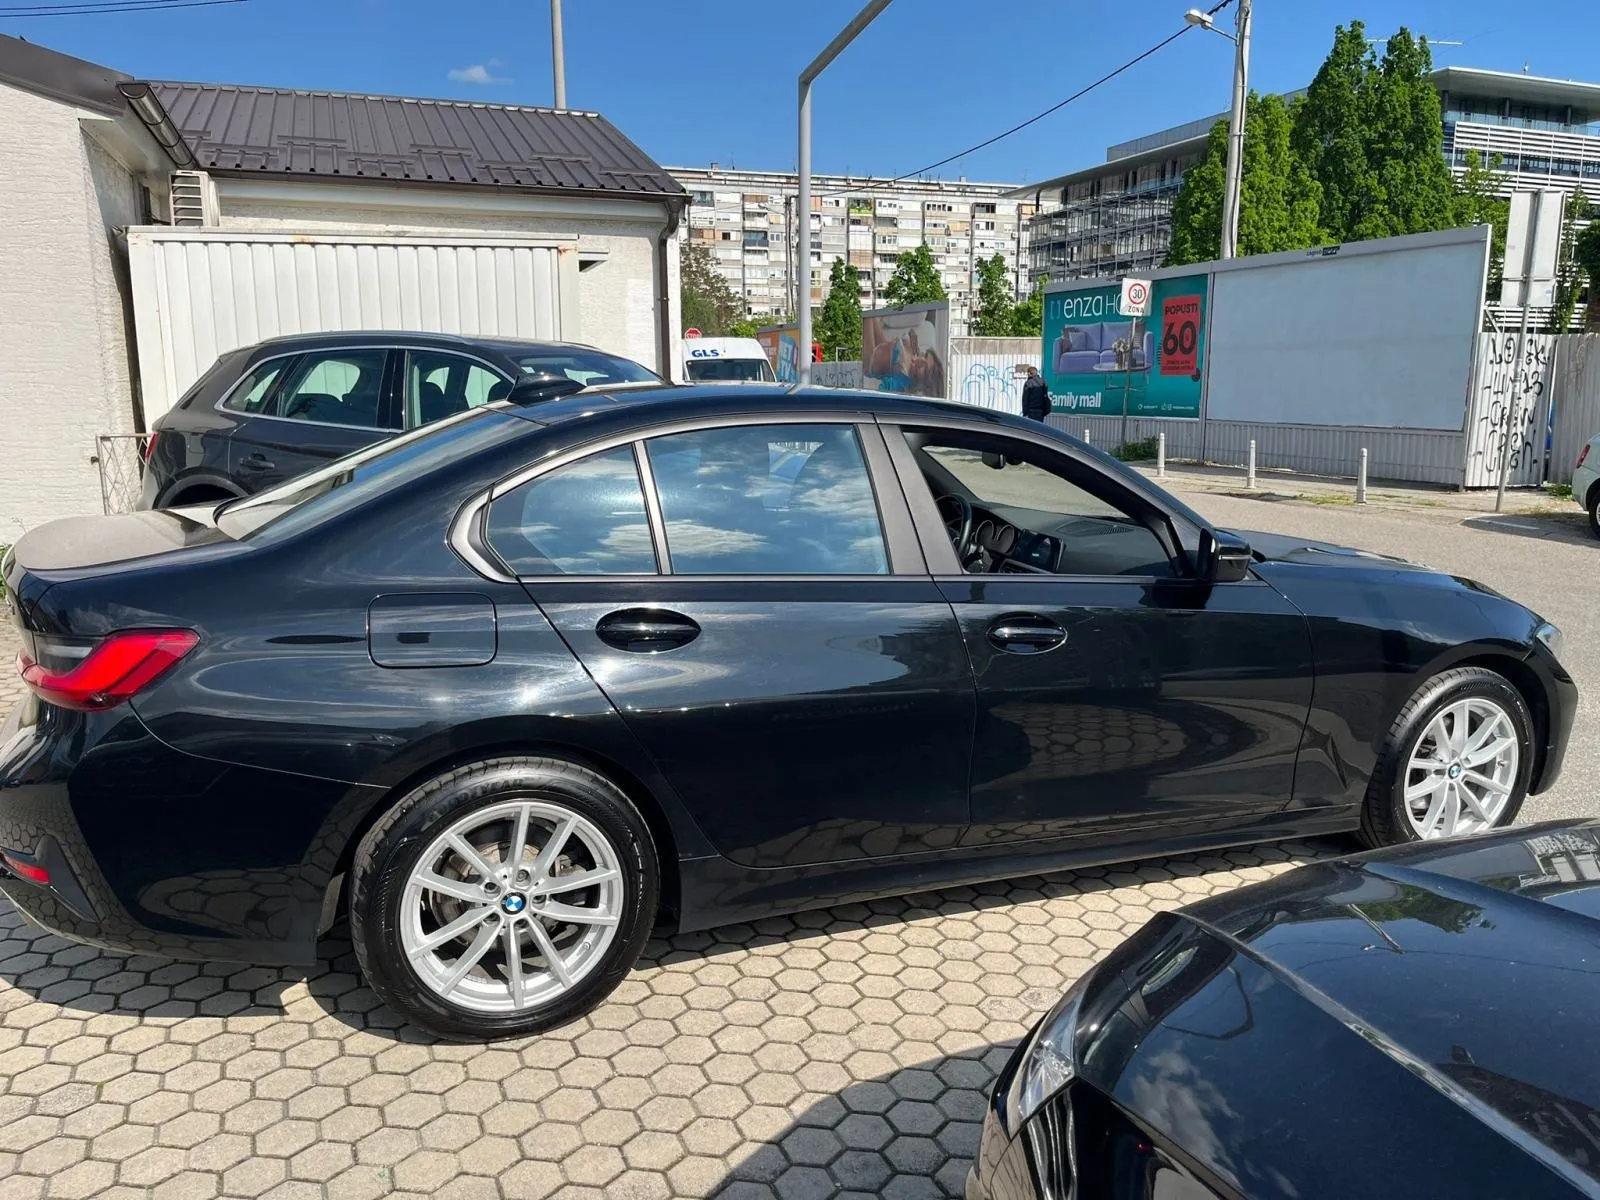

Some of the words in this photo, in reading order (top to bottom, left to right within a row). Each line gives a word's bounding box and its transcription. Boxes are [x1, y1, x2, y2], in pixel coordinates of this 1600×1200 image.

[1132, 289, 1143, 299] 30
[1063, 295, 1103, 319] enza
[1128, 306, 1145, 314] ZONA
[1164, 303, 1198, 315] POPUSTI
[1163, 321, 1196, 355] 60
[691, 349, 720, 358] GLS
[1079, 391, 1102, 408] mall
